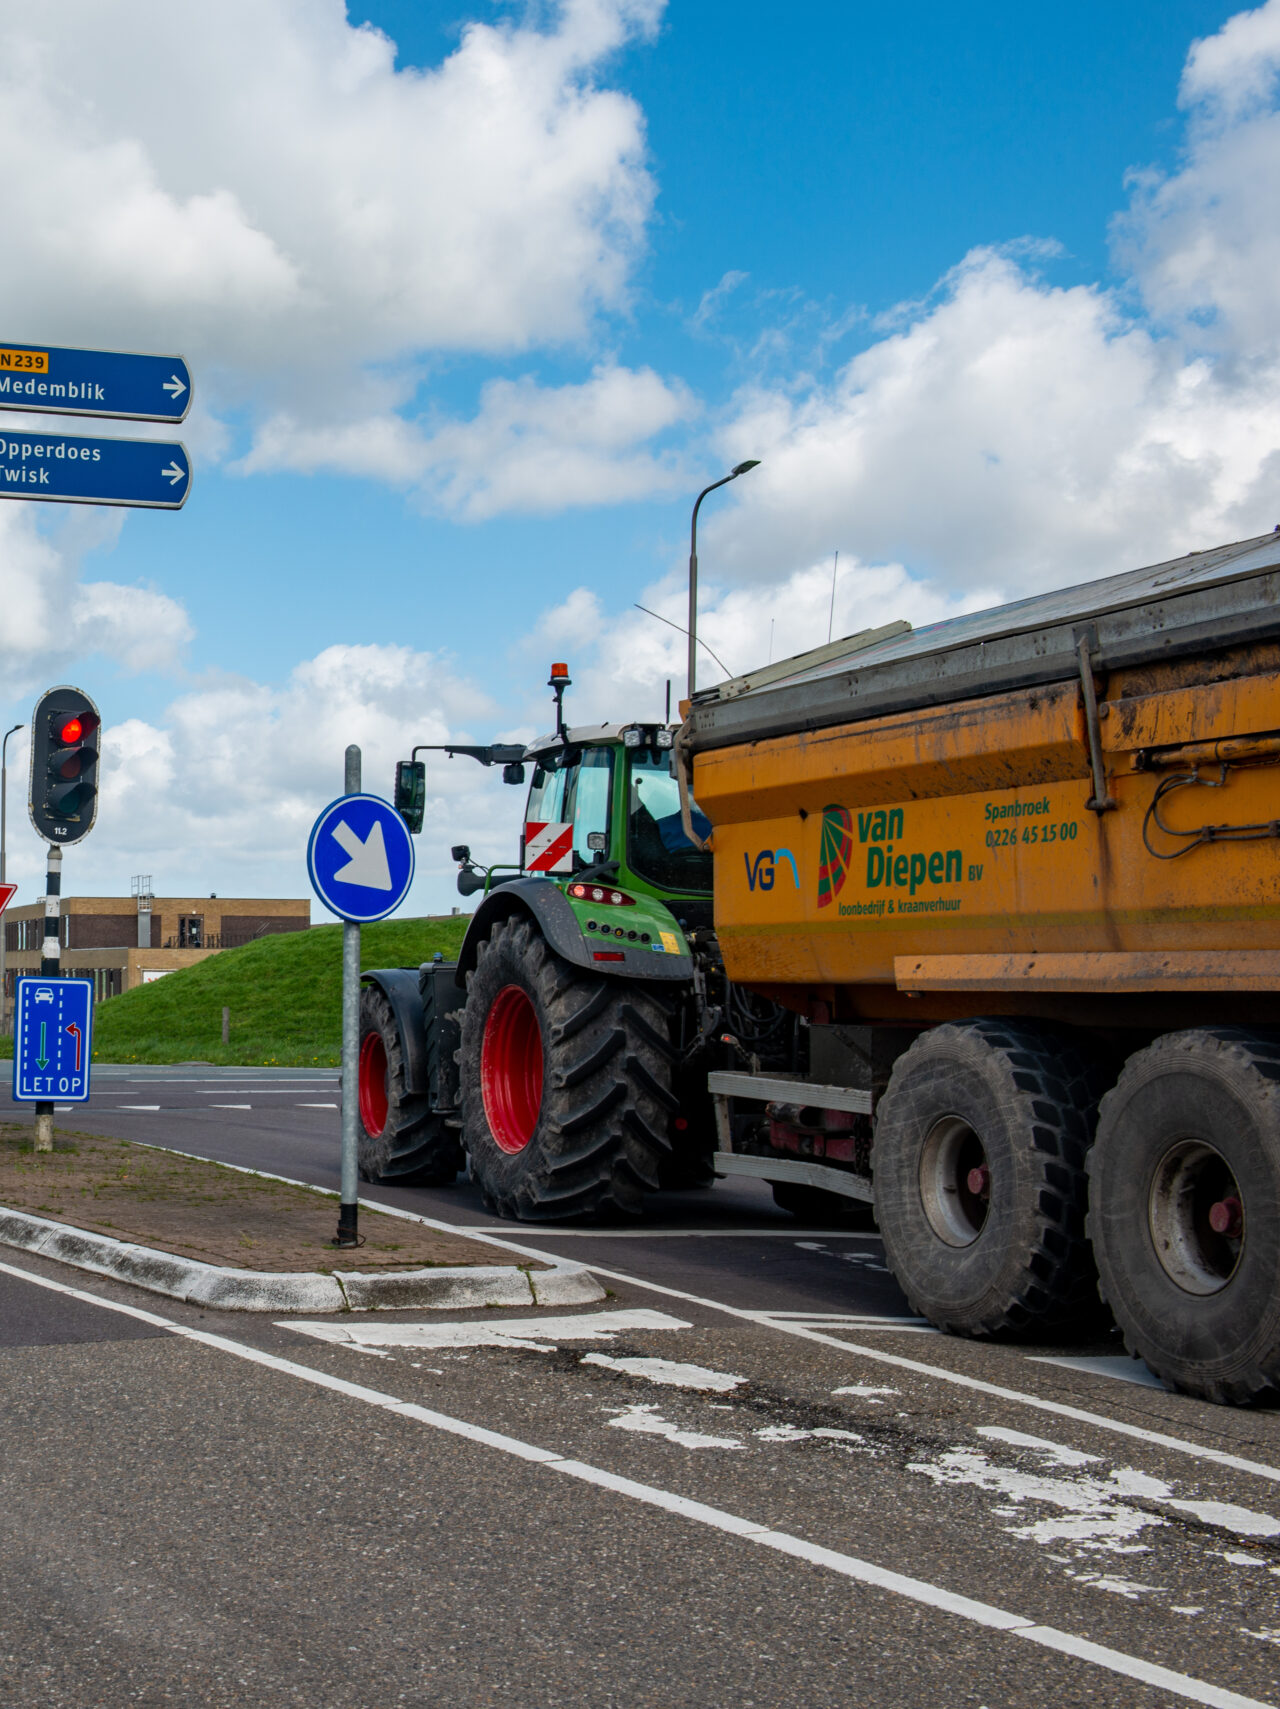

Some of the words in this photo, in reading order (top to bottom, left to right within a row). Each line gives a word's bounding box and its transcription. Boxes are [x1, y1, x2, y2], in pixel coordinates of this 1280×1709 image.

[984, 796, 1051, 825] Spanbroek
[857, 808, 904, 844] van
[985, 827, 1018, 848] 0226
[1021, 825, 1038, 844] 45
[1040, 823, 1058, 843] 15
[1060, 821, 1078, 841] 00
[866, 845, 963, 897] Diepen
[968, 864, 984, 882] BV
[838, 899, 886, 917] loonbedrijf
[887, 900, 895, 913] &
[897, 896, 962, 913] kraanverhuur
[23, 1077, 54, 1092] LET
[58, 1077, 81, 1093] OP
